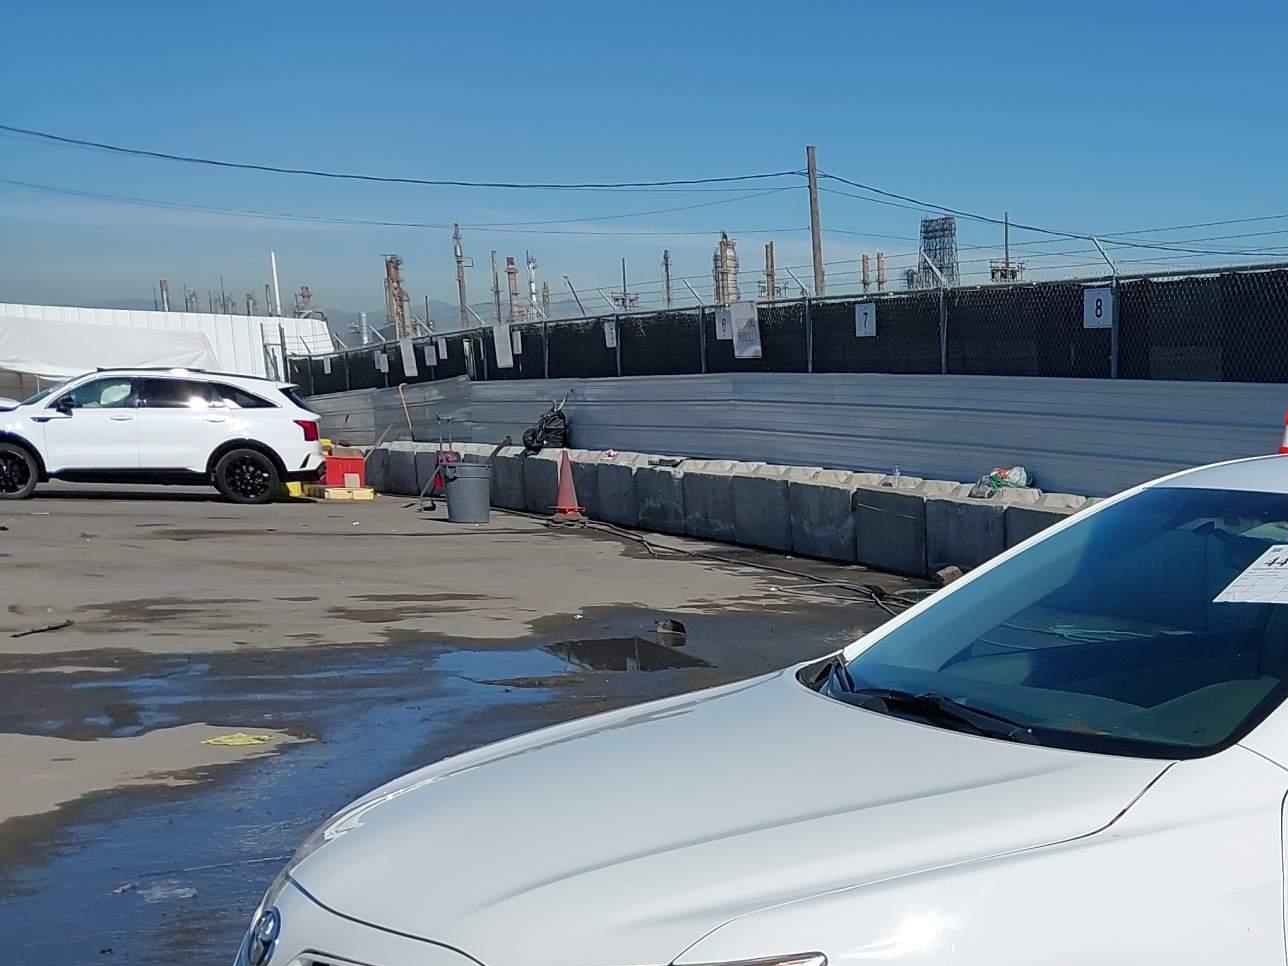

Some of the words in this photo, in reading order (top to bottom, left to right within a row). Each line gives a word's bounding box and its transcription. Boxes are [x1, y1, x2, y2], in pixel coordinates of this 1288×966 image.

[1094, 298, 1103, 318] 8
[720, 317, 727, 333] 6
[863, 311, 869, 329] 7
